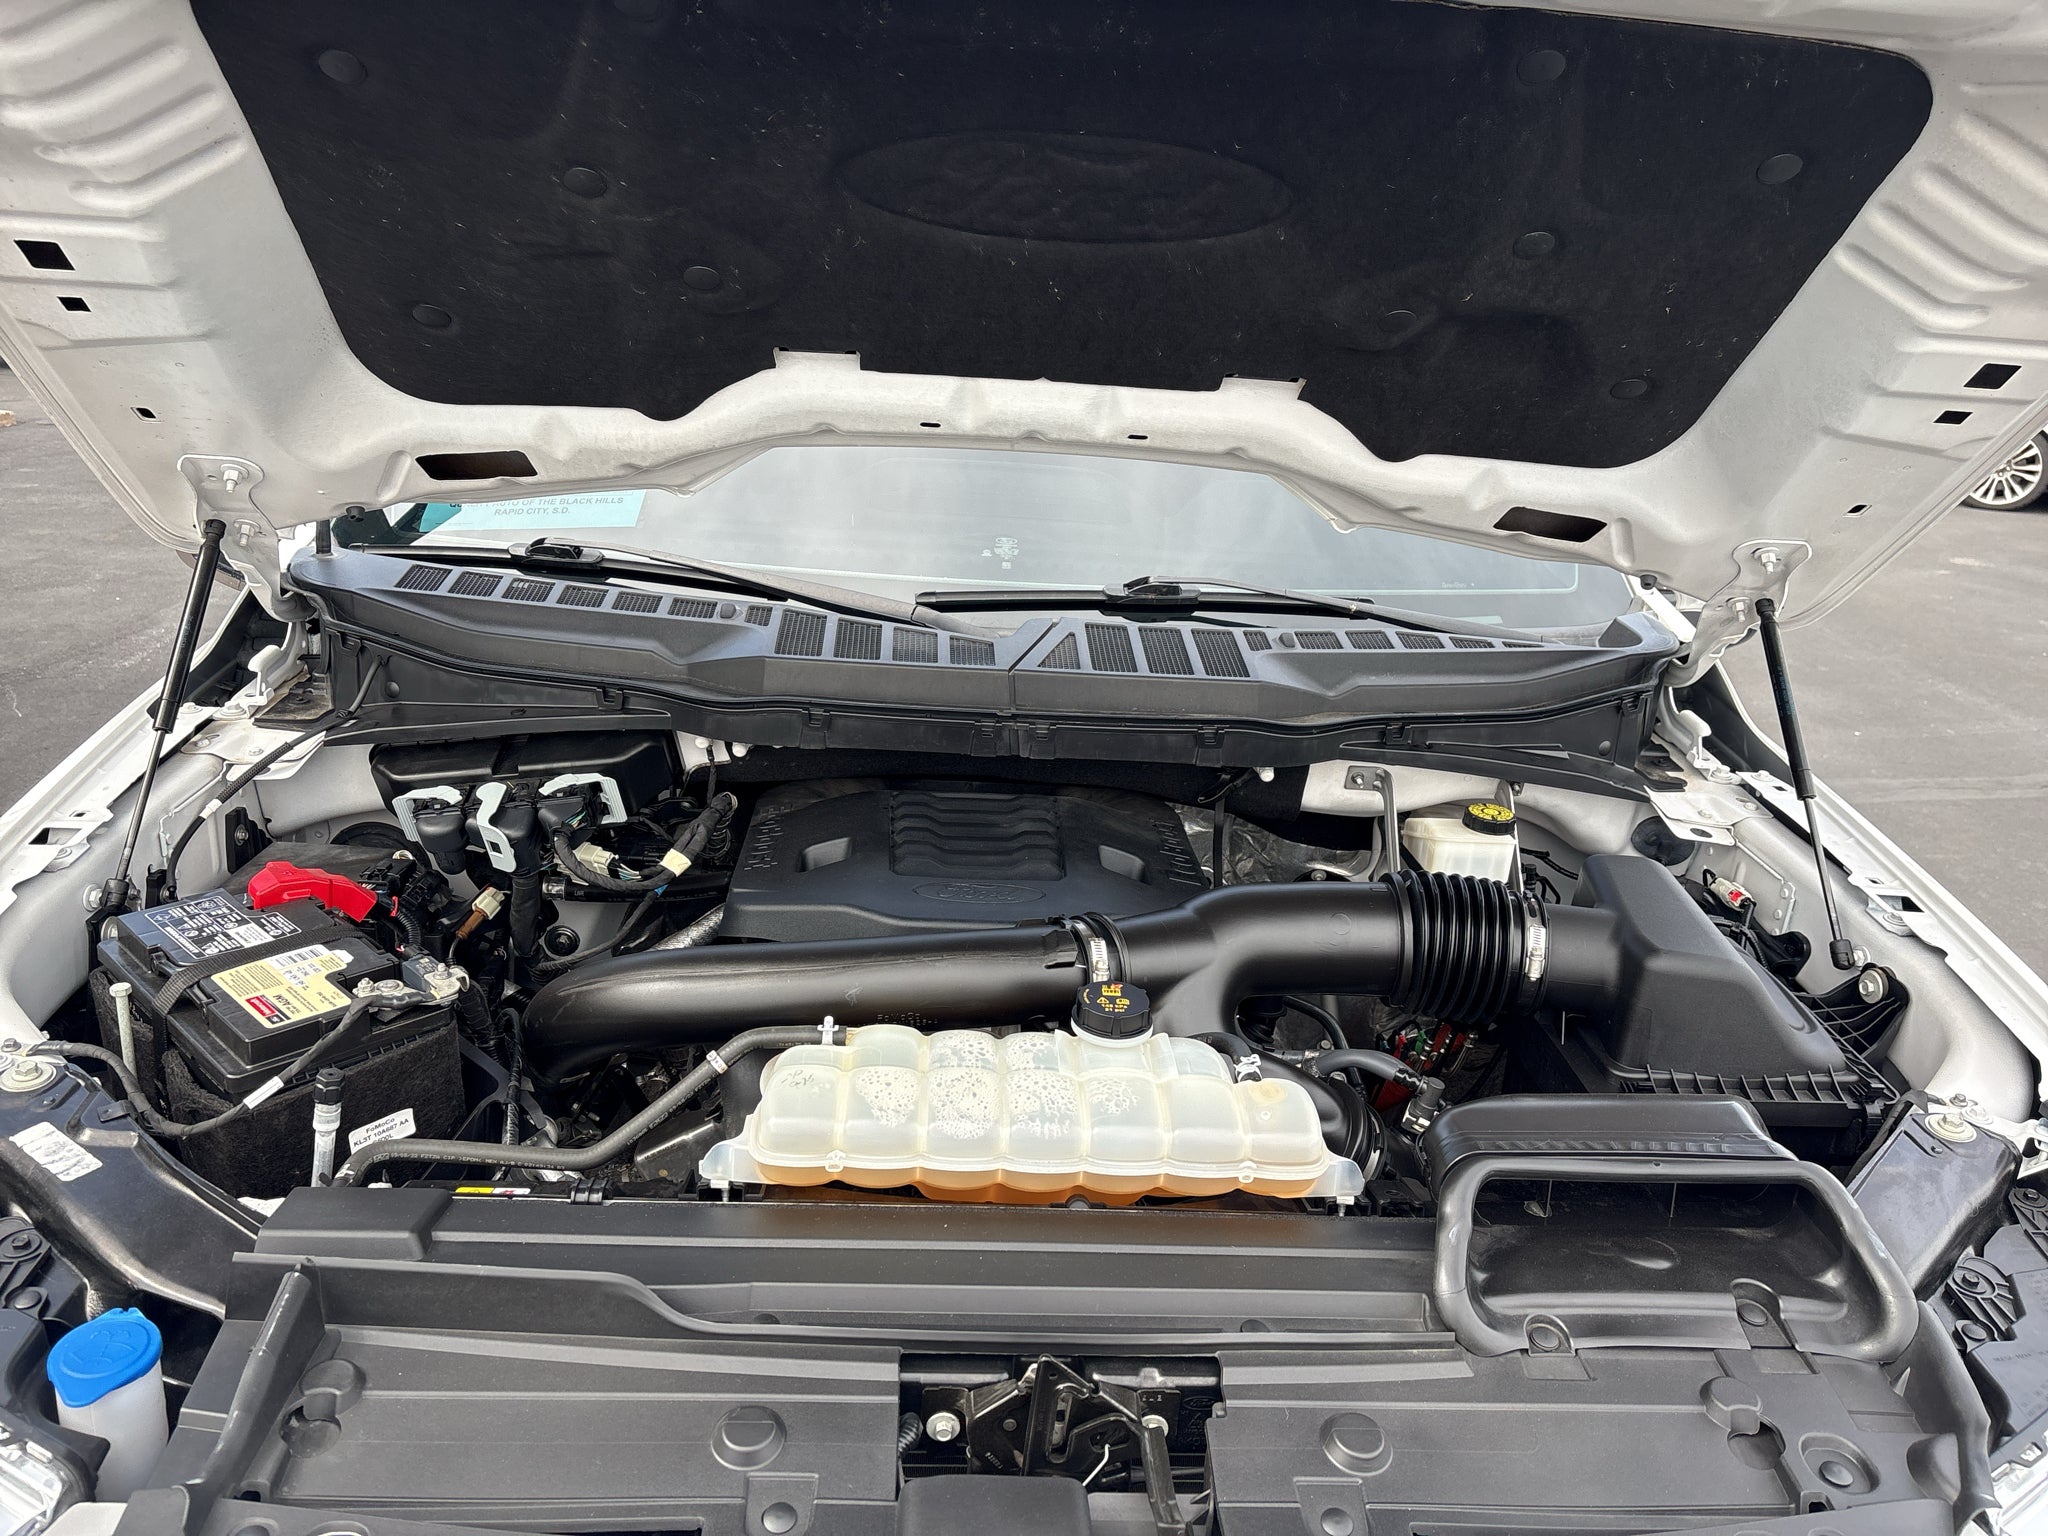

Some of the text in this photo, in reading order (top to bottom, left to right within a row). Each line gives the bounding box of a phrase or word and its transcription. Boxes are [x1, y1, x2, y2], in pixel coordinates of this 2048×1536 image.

[559, 497, 594, 505] BLACK
[594, 496, 624, 504] HILLS
[494, 508, 524, 516] RAPID
[526, 507, 549, 515] CITY,
[365, 1117, 395, 1134] FoMoCo
[399, 1118, 409, 1127] AA
